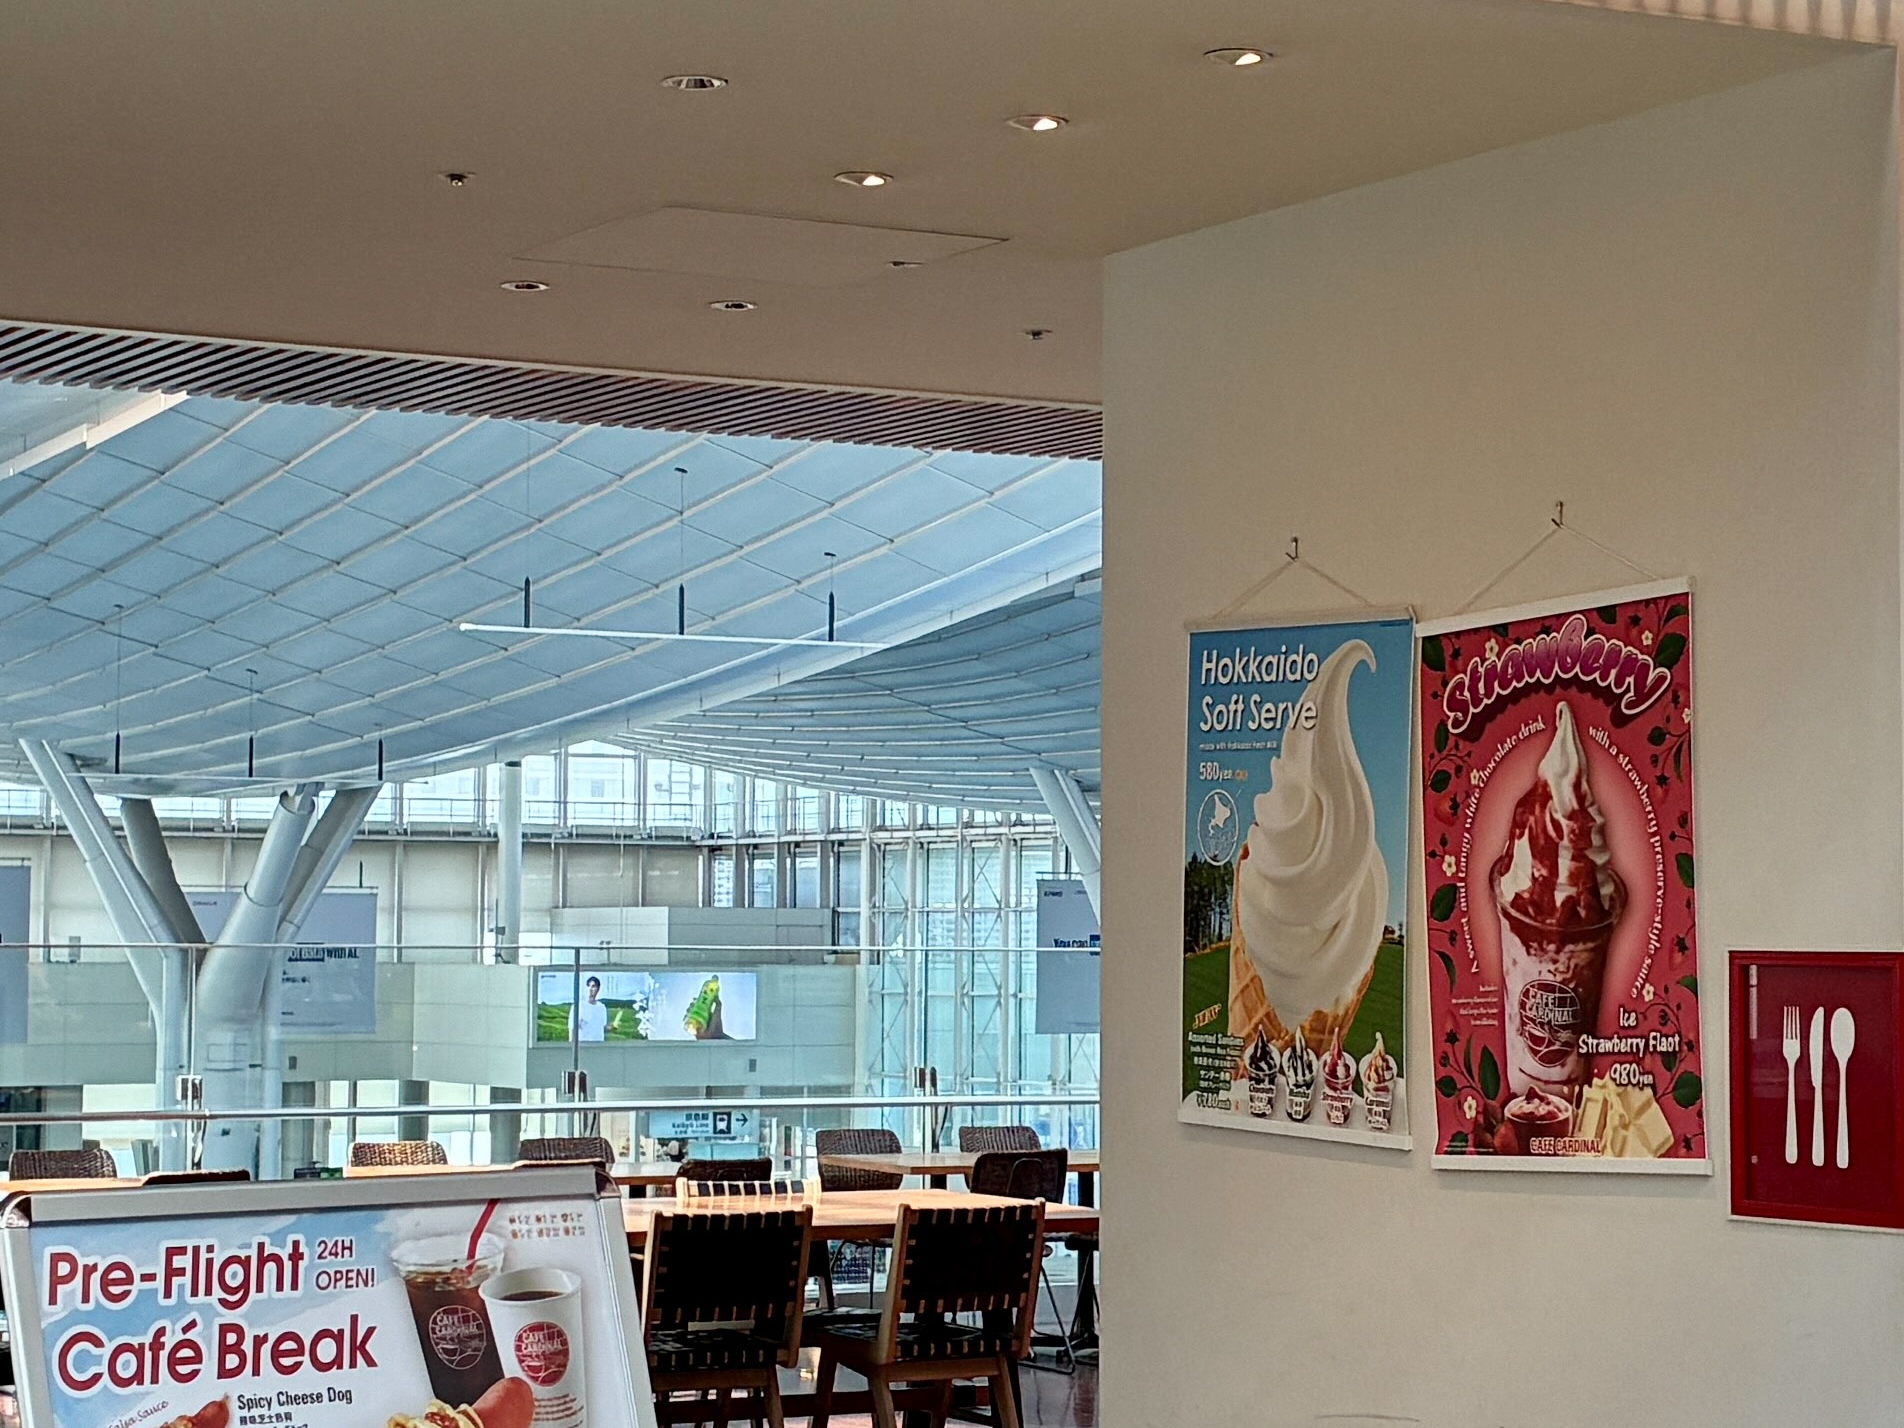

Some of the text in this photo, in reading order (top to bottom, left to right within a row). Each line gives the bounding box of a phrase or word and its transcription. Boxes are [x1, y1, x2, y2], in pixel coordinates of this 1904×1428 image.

[1201, 644, 1319, 685] Hokkaido
[1444, 614, 1670, 734] Strawberry
[1199, 694, 1318, 732] Soft Serve
[1519, 715, 1547, 739] drink
[1588, 725, 1610, 749] with
[1478, 735, 1518, 785] chocolate
[1464, 788, 1481, 829] white
[1616, 753, 1658, 833] strawberry
[1458, 832, 1472, 878] tangy
[1457, 883, 1468, 911] and
[1461, 917, 1474, 959] sweet
[1631, 955, 1652, 999] sauce
[1529, 990, 1555, 1008] CAFE
[1618, 1007, 1638, 1027] Ice
[1578, 1032, 1680, 1057] Strawberry Flaot
[1529, 1138, 1602, 1154] CAFE CARDINAL
[315, 1239, 354, 1260] 24H
[48, 1240, 304, 1311] Pre-Flight
[315, 1267, 375, 1291] OPEN!
[58, 1314, 378, 1392] Café Break
[236, 1387, 353, 1413] Spicy Cheese Dog
